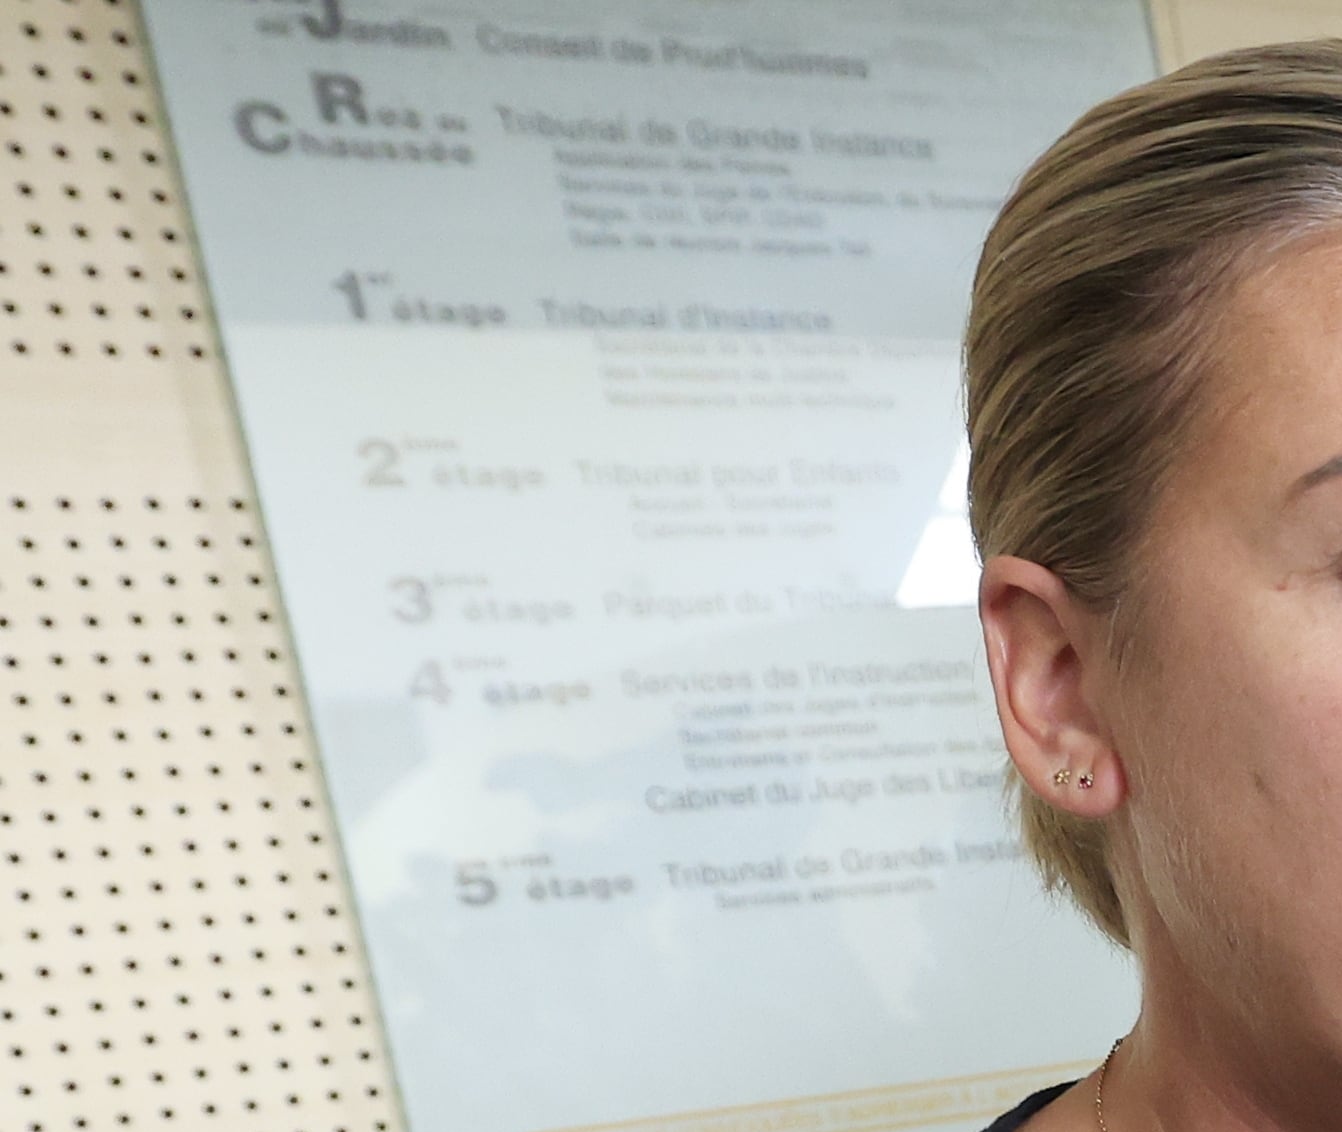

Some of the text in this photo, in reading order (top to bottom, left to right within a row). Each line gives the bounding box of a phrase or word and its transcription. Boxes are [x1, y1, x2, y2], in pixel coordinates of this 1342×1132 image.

[475, 23, 601, 60] Conseil
[610, 38, 653, 64] de
[495, 104, 935, 160] Tribunal de Grande Instance
[391, 294, 508, 330] étage
[537, 298, 667, 331] Tribunal
[430, 462, 547, 495] étage
[575, 458, 701, 488] Tribunal
[711, 463, 778, 491] pour
[461, 597, 576, 629] étage
[781, 585, 900, 613] Tribuna
[482, 676, 593, 708] étage
[620, 668, 752, 700] Services
[763, 664, 799, 692] de
[646, 782, 758, 814] Cabinet
[765, 781, 802, 804] du
[808, 776, 875, 806] Juge
[883, 772, 932, 796] des
[662, 856, 786, 889] Tribunal
[794, 854, 831, 880] de
[840, 845, 948, 875] Grande
[525, 874, 635, 903] étage
